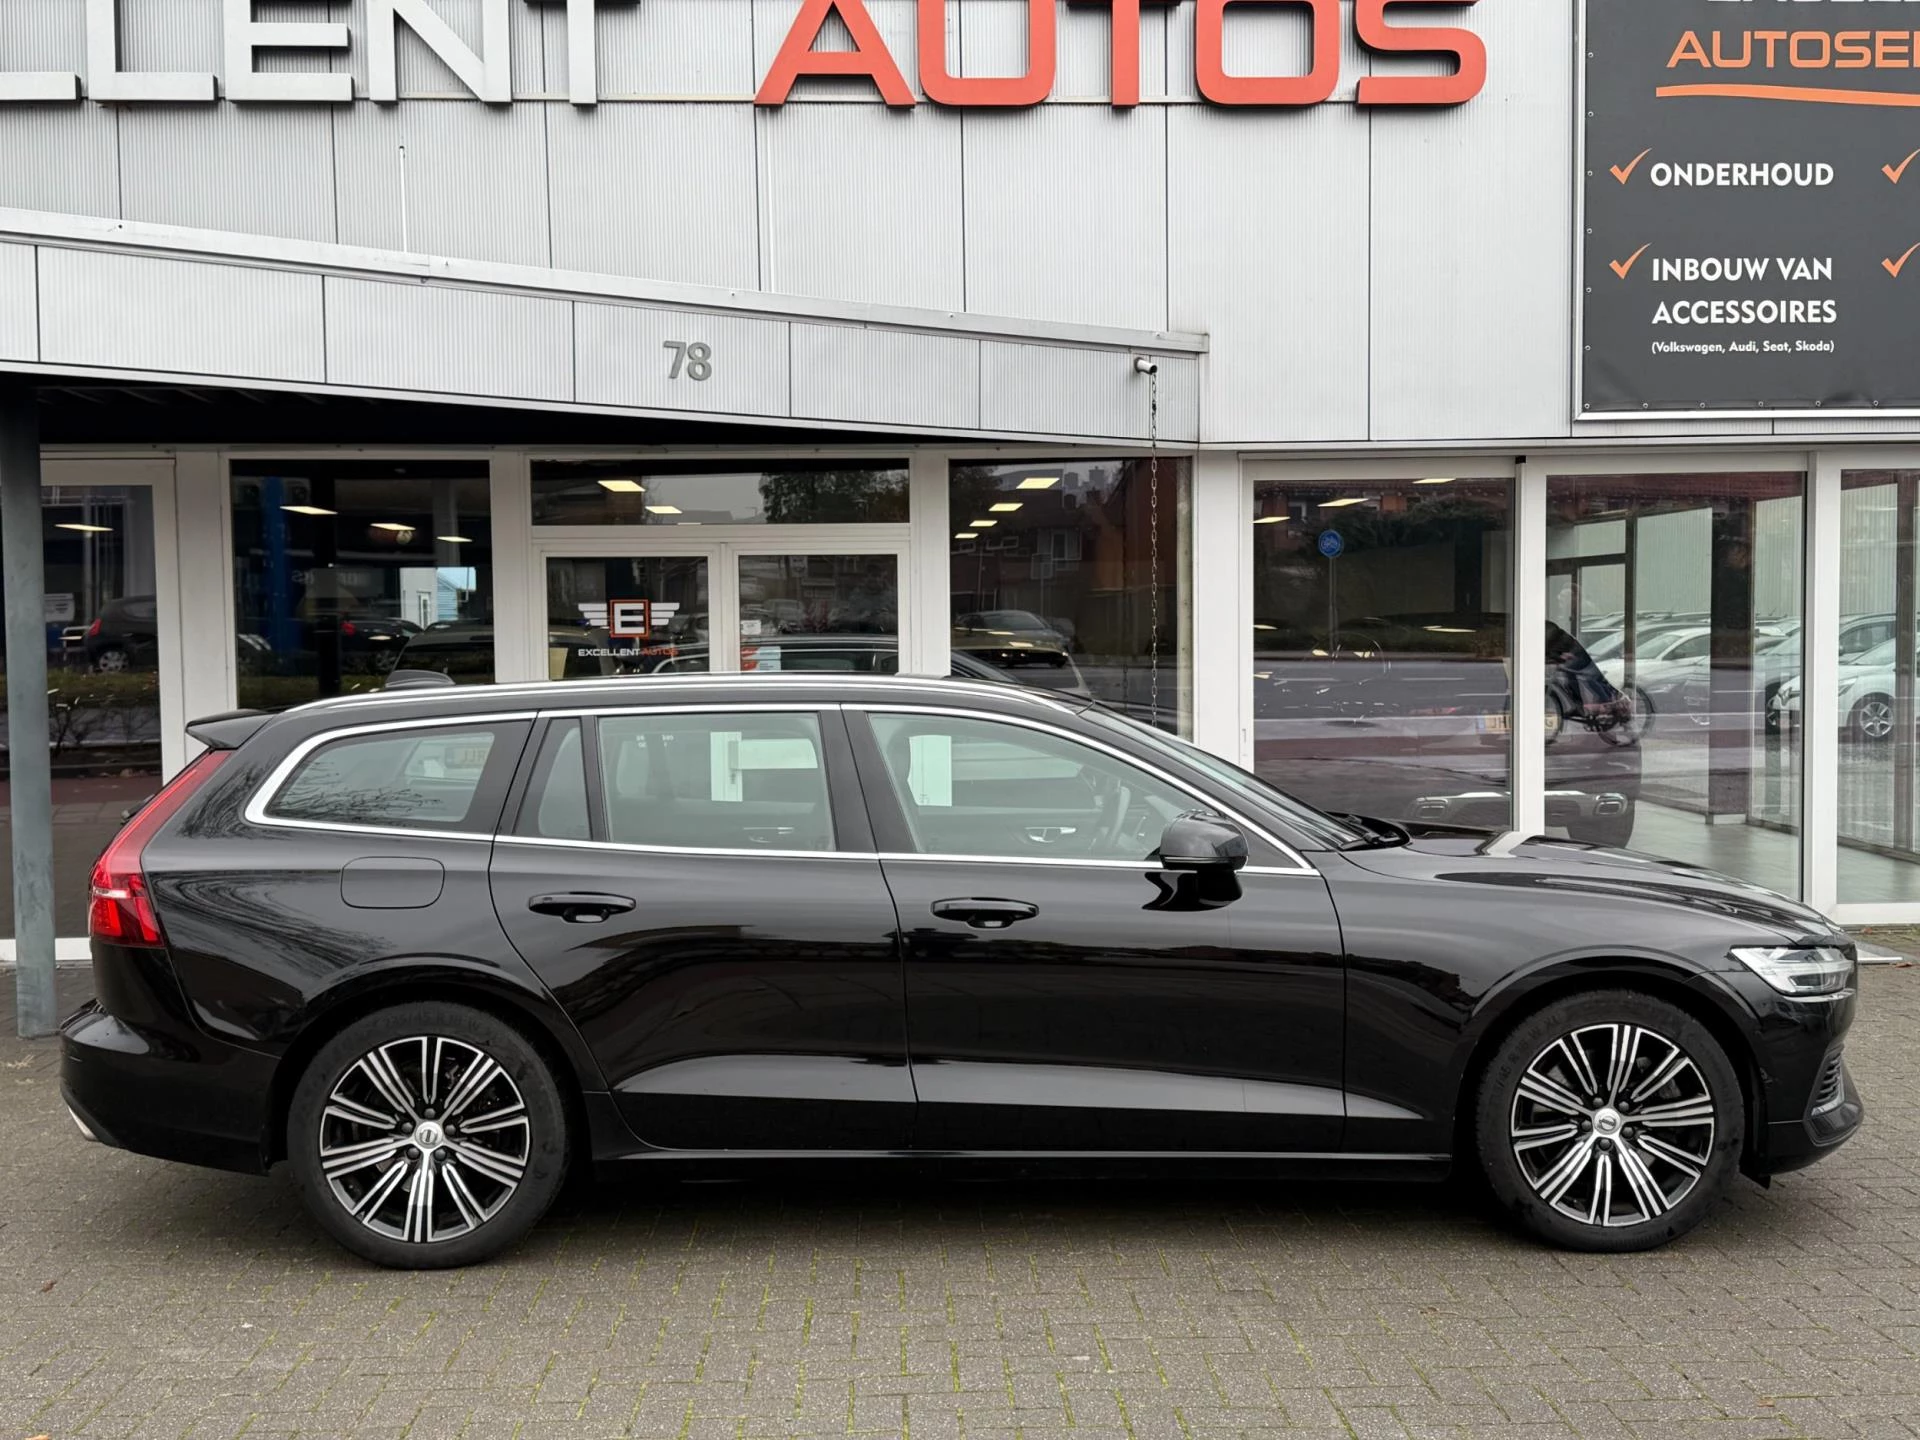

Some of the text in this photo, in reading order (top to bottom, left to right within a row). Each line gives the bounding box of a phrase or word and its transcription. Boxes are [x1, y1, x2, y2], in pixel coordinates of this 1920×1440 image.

[754, 0, 1487, 106] AUTOS
[1650, 163, 1834, 187] ONDERHOUD
[1652, 257, 1832, 282] INBOUW VAN
[1651, 299, 1837, 325] ACCESSOIRES
[1651, 339, 1835, 355] (Volkswagen, Audi, Seat, Skoda)
[663, 340, 713, 381] 78
[613, 602, 646, 634] E
[577, 648, 640, 657] EXCELLENT
